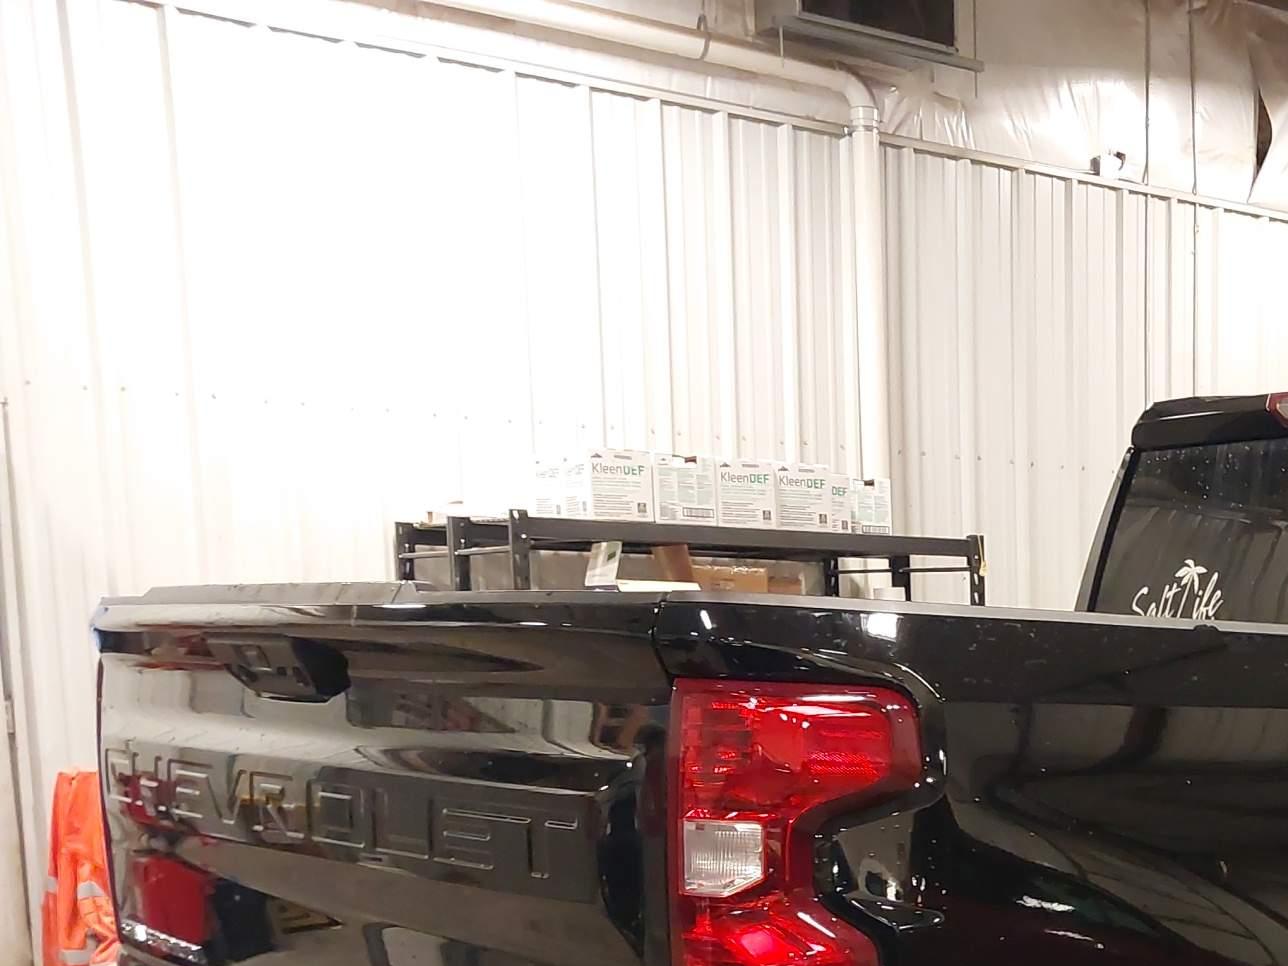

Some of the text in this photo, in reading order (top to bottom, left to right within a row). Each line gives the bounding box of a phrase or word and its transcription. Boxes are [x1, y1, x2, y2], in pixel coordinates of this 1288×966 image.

[720, 471, 769, 484] KleenDEF
[778, 475, 826, 489] KleenDEF
[104, 746, 579, 879] CHEVROLET
